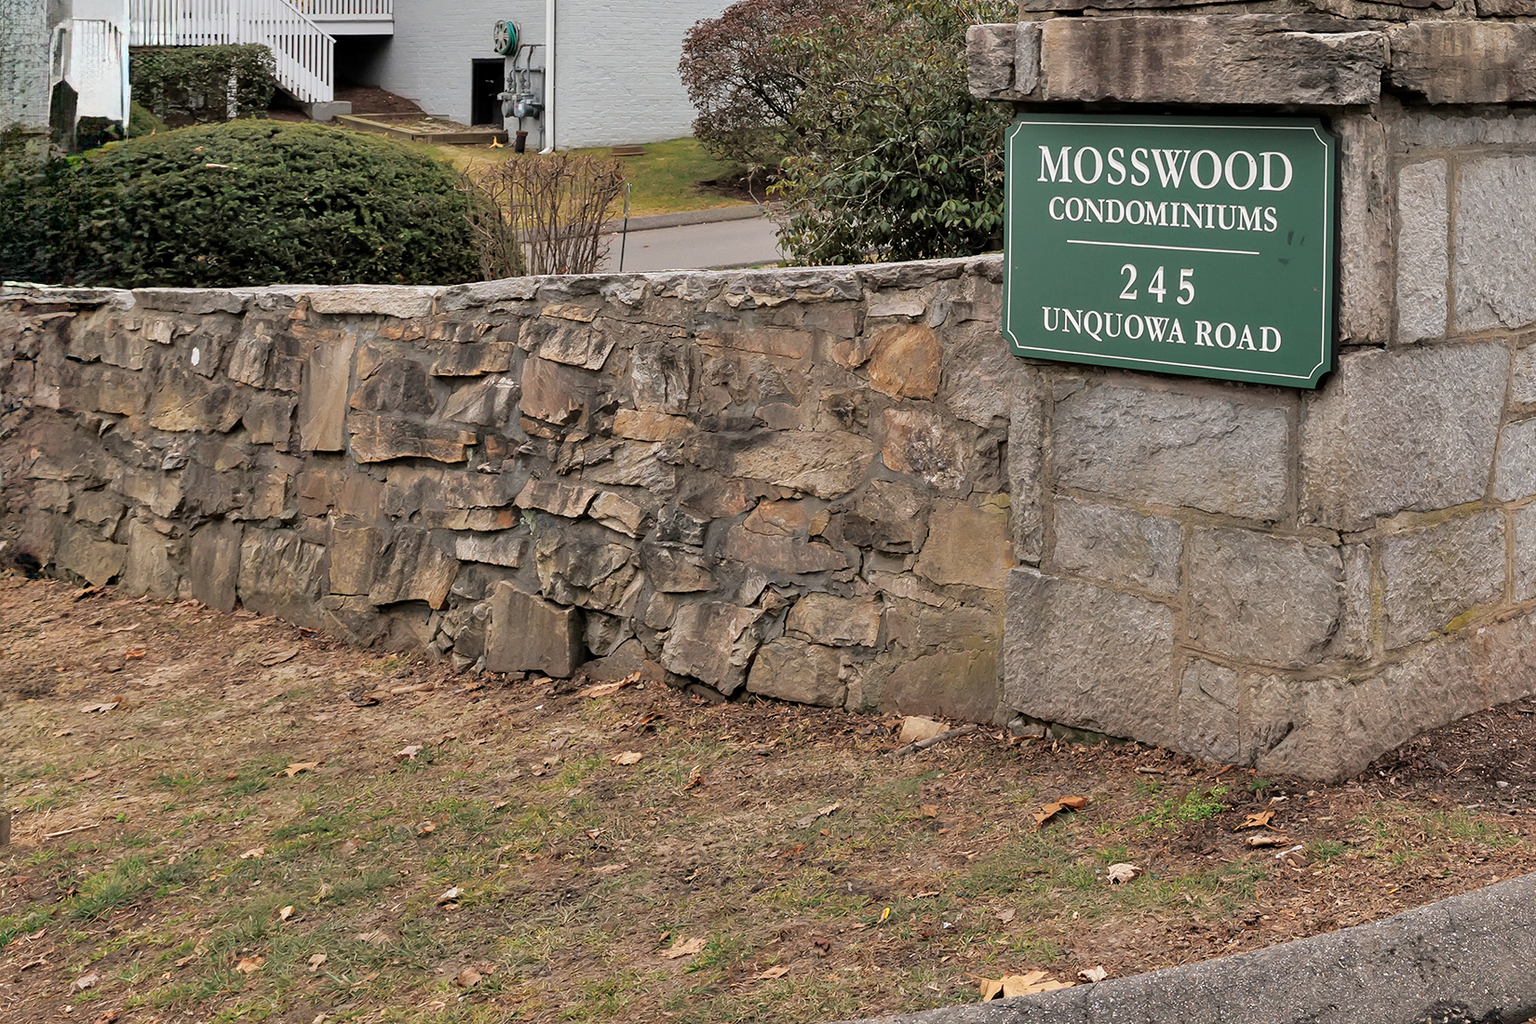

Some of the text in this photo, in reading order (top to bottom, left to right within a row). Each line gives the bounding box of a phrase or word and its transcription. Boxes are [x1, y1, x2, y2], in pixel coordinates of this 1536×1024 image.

[1037, 145, 1293, 192] MOSSWOOD
[1048, 196, 1278, 232] CONDOMINIUMS
[1119, 263, 1195, 305] 245
[1041, 307, 1282, 353] UNQUOWA ROAD
